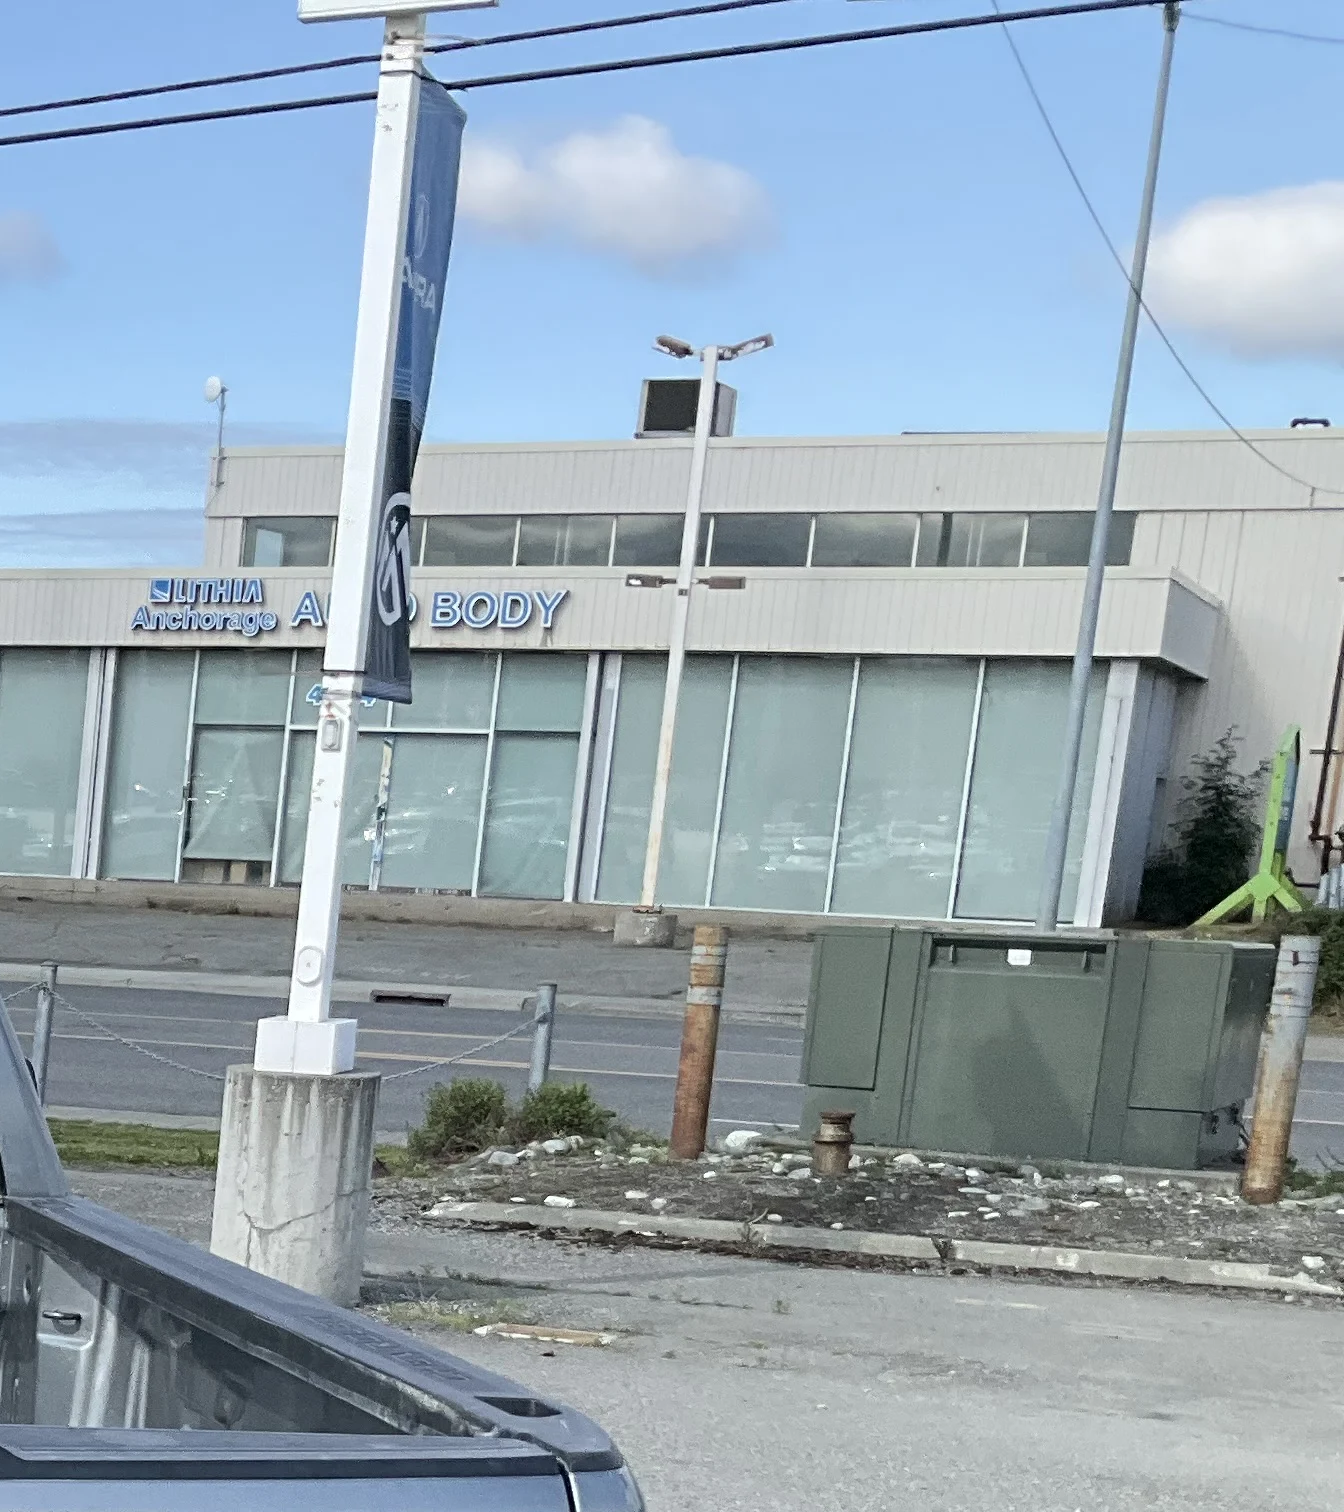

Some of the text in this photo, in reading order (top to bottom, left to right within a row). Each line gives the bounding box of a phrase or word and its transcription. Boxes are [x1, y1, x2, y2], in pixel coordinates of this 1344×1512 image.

[172, 577, 263, 605] LITHIA
[130, 605, 279, 637] Anchorage
[429, 588, 570, 630] BODY
